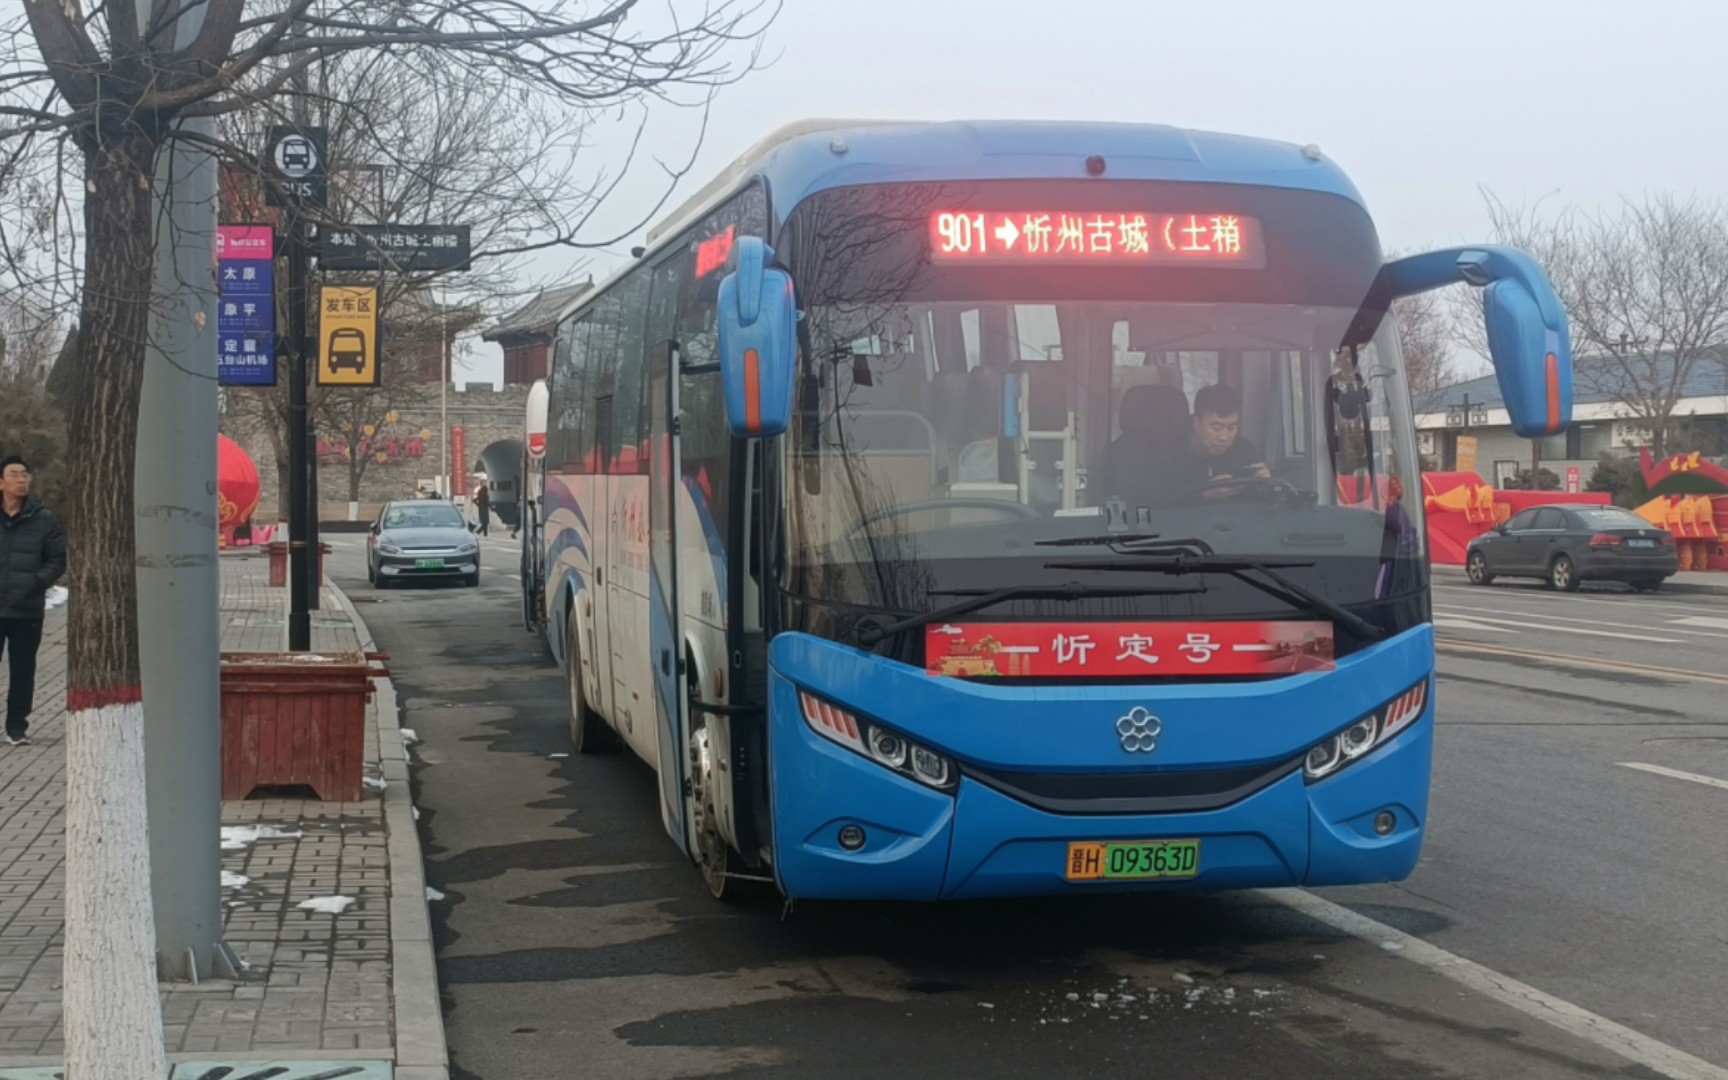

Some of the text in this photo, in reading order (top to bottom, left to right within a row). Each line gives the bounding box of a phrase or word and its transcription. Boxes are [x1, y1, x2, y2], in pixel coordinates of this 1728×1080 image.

[330, 232, 357, 246] 本站
[938, 213, 986, 253] 901
[224, 267, 256, 280] 太原
[224, 303, 256, 316] 原平
[326, 297, 371, 313] 发车区
[1051, 632, 1222, 666] 忻定号
